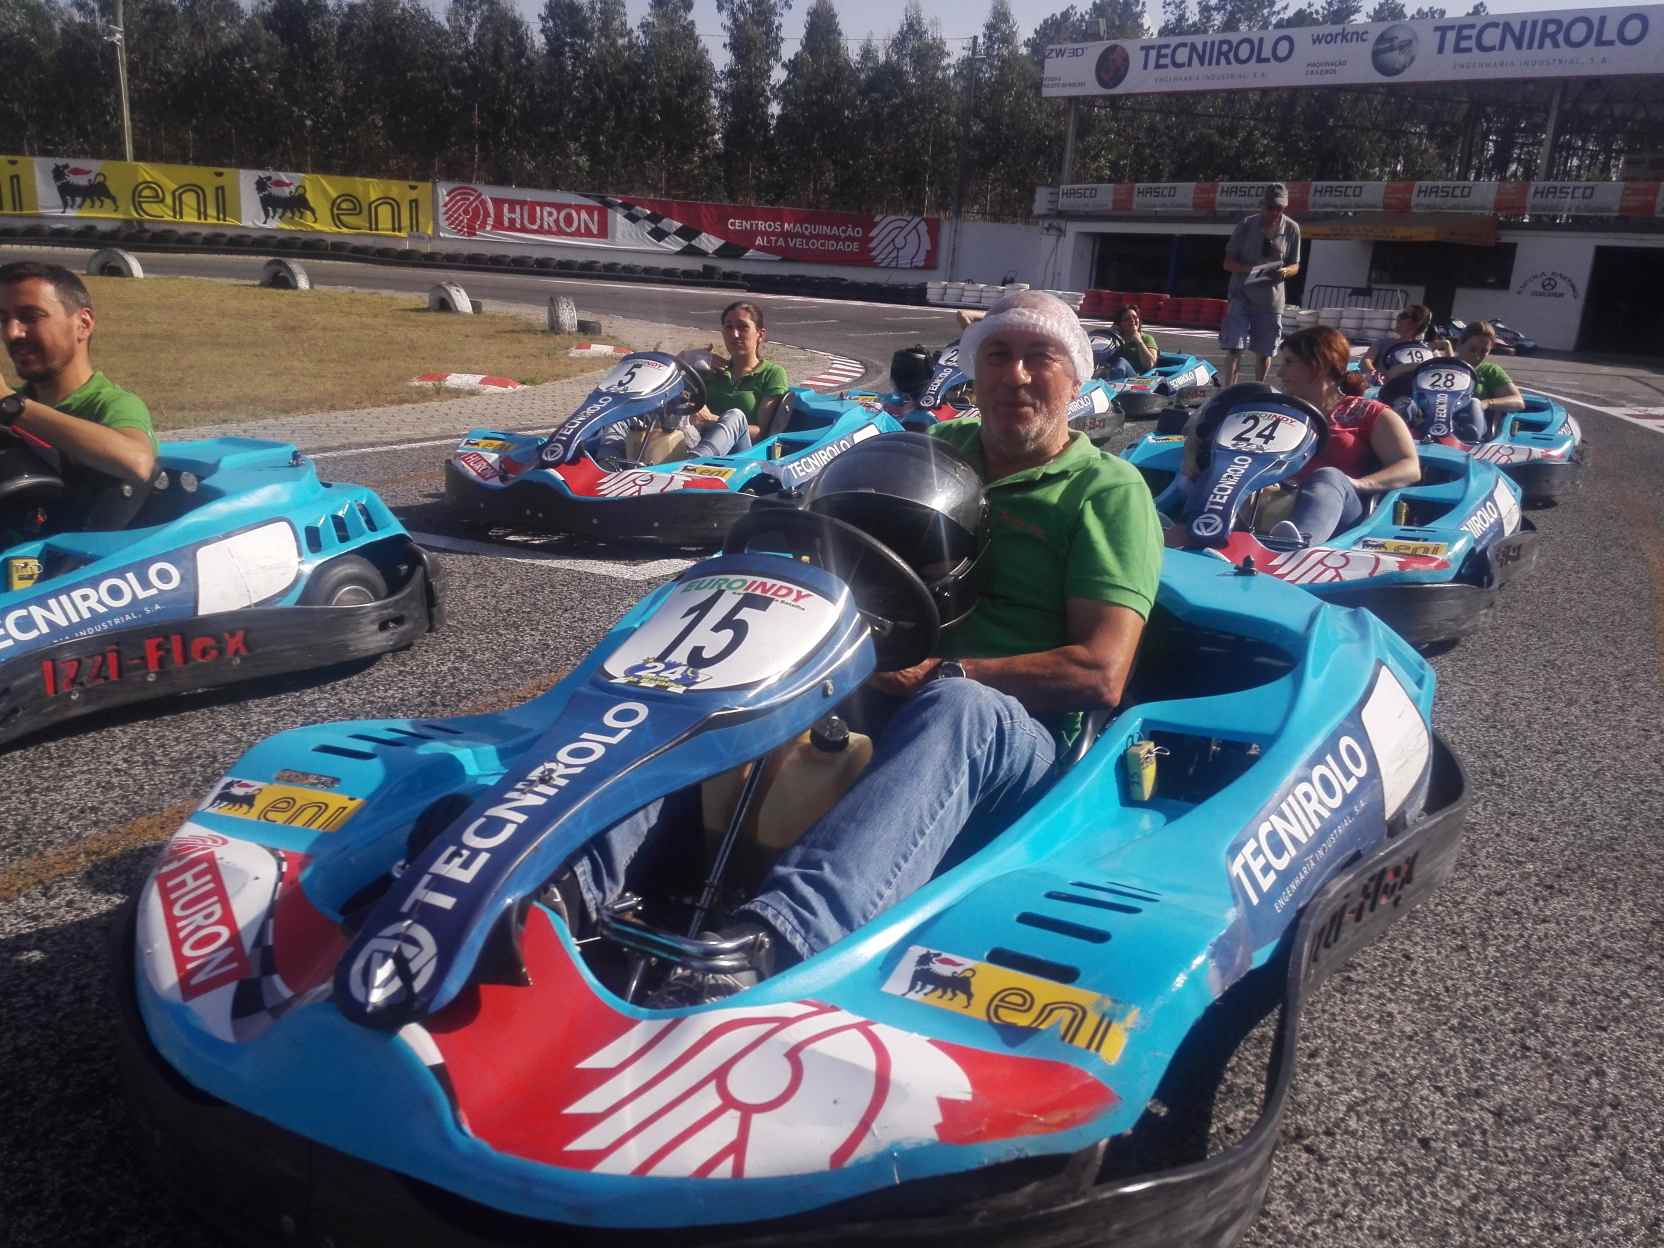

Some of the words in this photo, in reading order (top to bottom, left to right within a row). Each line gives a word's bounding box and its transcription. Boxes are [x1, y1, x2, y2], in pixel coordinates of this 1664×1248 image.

[1432, 12, 1650, 56] TECNIROLO
[1139, 34, 1295, 71] TECNIROLO
[131, 171, 228, 222] eni
[1061, 186, 1098, 199] HASCO
[1136, 186, 1177, 198] HASCO
[1219, 185, 1265, 198] HASCO
[1312, 184, 1363, 199] HASCO
[1416, 184, 1472, 199] HASCO
[1532, 185, 1595, 200] HASCO
[330, 184, 420, 233] eni
[502, 203, 600, 235] HURON
[727, 218, 782, 233] CENTROS
[783, 220, 864, 238] MAQUINAÇÃO
[754, 234, 793, 248] ALTA
[794, 236, 861, 252] VELOCIDADE
[1407, 350, 1424, 362] 19
[617, 363, 644, 387] 5
[1429, 372, 1456, 388] 28
[1231, 414, 1281, 445] 24
[1204, 455, 1253, 513] TECNIROLO
[1393, 543, 1441, 555] eni
[682, 578, 815, 604] EUROINDY
[680, 588, 778, 669] 15
[257, 795, 358, 831] eni
[401, 701, 649, 913] TECNIROLO
[1231, 735, 1368, 906] TECNIROLO
[165, 861, 240, 986] HURON
[986, 986, 1113, 1053] eni
